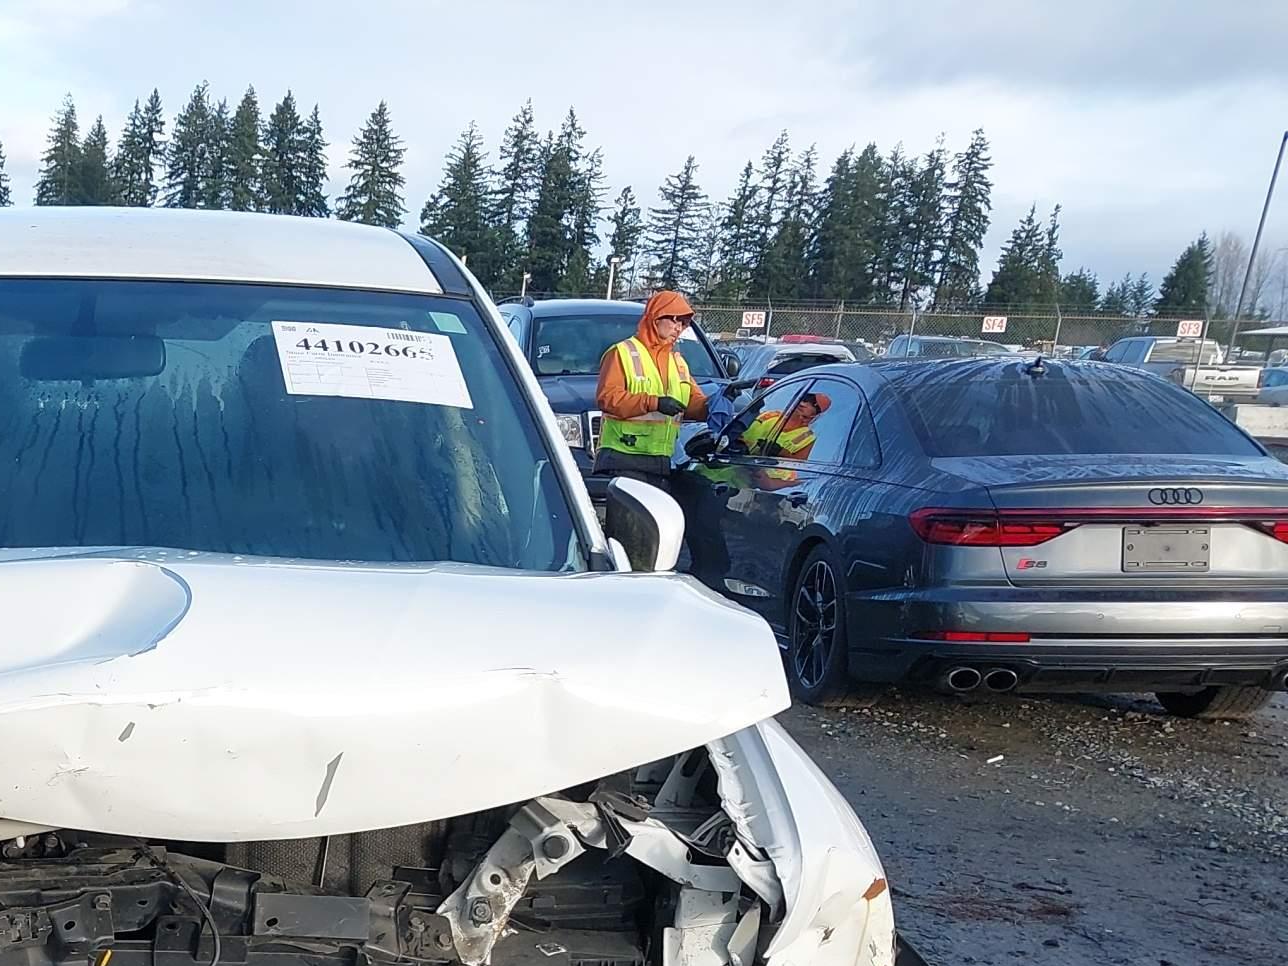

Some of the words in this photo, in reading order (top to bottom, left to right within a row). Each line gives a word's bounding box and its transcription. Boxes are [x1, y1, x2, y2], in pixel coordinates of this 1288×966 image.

[744, 313, 764, 326] SF5
[985, 319, 1004, 331] SF4
[1179, 322, 1200, 335] SF3
[295, 337, 434, 361] 44102665
